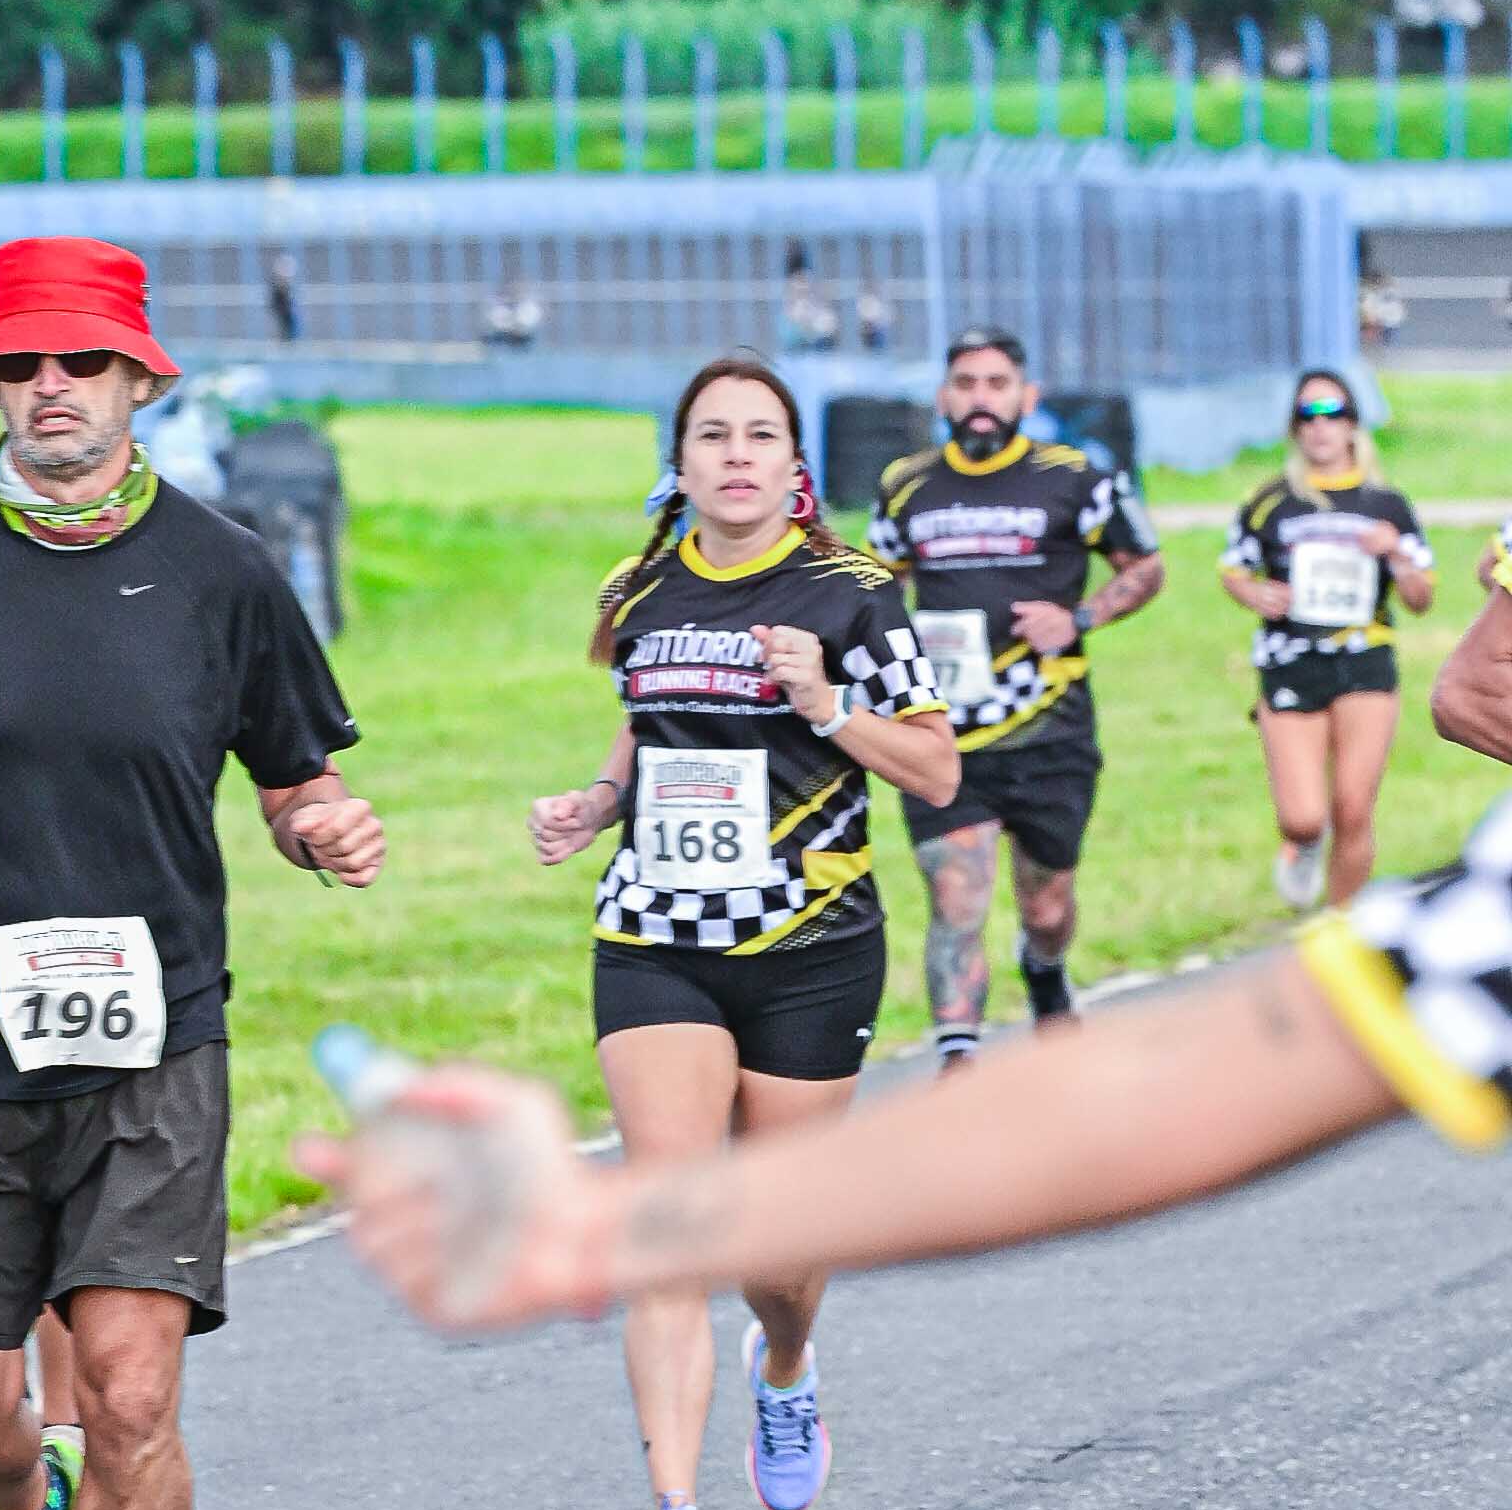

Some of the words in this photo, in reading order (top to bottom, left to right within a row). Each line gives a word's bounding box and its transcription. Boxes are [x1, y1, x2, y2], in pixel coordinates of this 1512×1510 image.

[638, 669, 712, 693] RUNNING
[711, 671, 760, 698] RACE
[654, 820, 740, 863] 168
[20, 990, 134, 1040] 196
